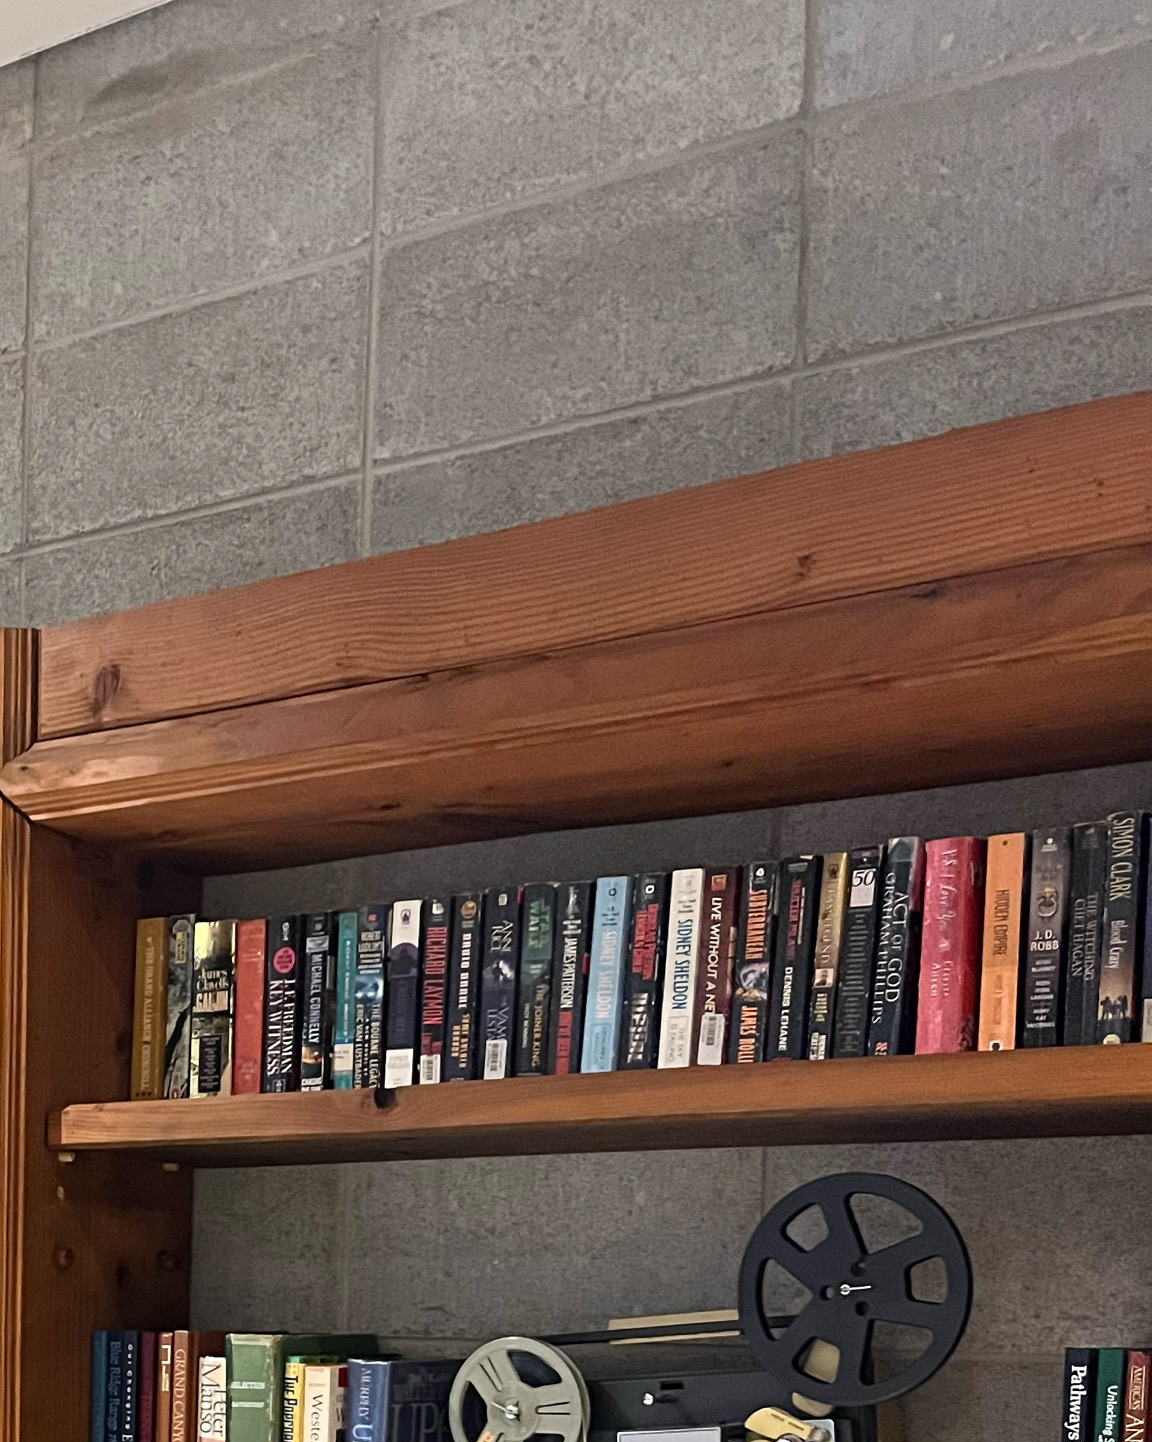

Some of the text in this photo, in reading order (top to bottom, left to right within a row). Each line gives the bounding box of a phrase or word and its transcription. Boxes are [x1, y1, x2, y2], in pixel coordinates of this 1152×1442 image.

[852, 870, 875, 886] 50
[1109, 817, 1135, 900] SIMON CLARK
[424, 927, 447, 974] RICHARD
[600, 931, 618, 966] SIDNEY
[706, 897, 722, 990] LIVE WITHOUT A
[745, 889, 766, 960] SUBTERRANEAN
[872, 872, 896, 1024] GRAHAM PHILLIPS
[885, 892, 908, 1002] ACT GOD
[993, 925, 1008, 956] EMPIRE
[1030, 941, 1059, 951] ROBB
[1084, 920, 1097, 981] WITCHING
[1106, 920, 1128, 969] Blood Crazy
[560, 937, 578, 1008] JAMES PATTERSON
[672, 919, 693, 1010] SIDNEY SHELDON
[1072, 934, 1084, 978] HAGAN
[308, 954, 324, 1044] MICHAEL CONNELLY
[422, 979, 444, 1024] LAYMON
[596, 970, 615, 1018] SHELDON
[741, 1006, 758, 1035] JAMES
[778, 967, 792, 1052] DENNIS LEHANE
[267, 980, 283, 1076] KEY WITNESS
[280, 1004, 295, 1074] FREEDMAN
[531, 1005, 543, 1066] JOINER KING
[106, 1342, 121, 1431] Blue Ridge Range
[174, 1349, 185, 1398] GRAND
[200, 1363, 221, 1433] Manso
[284, 1376, 298, 1395] THE
[358, 1368, 371, 1418] MURPHY
[1130, 1365, 1144, 1410] AMERICA'S
[213, 1390, 226, 1437] Peter
[1063, 1365, 1087, 1440] Pathways
[1102, 1385, 1118, 1436] Unlocking
